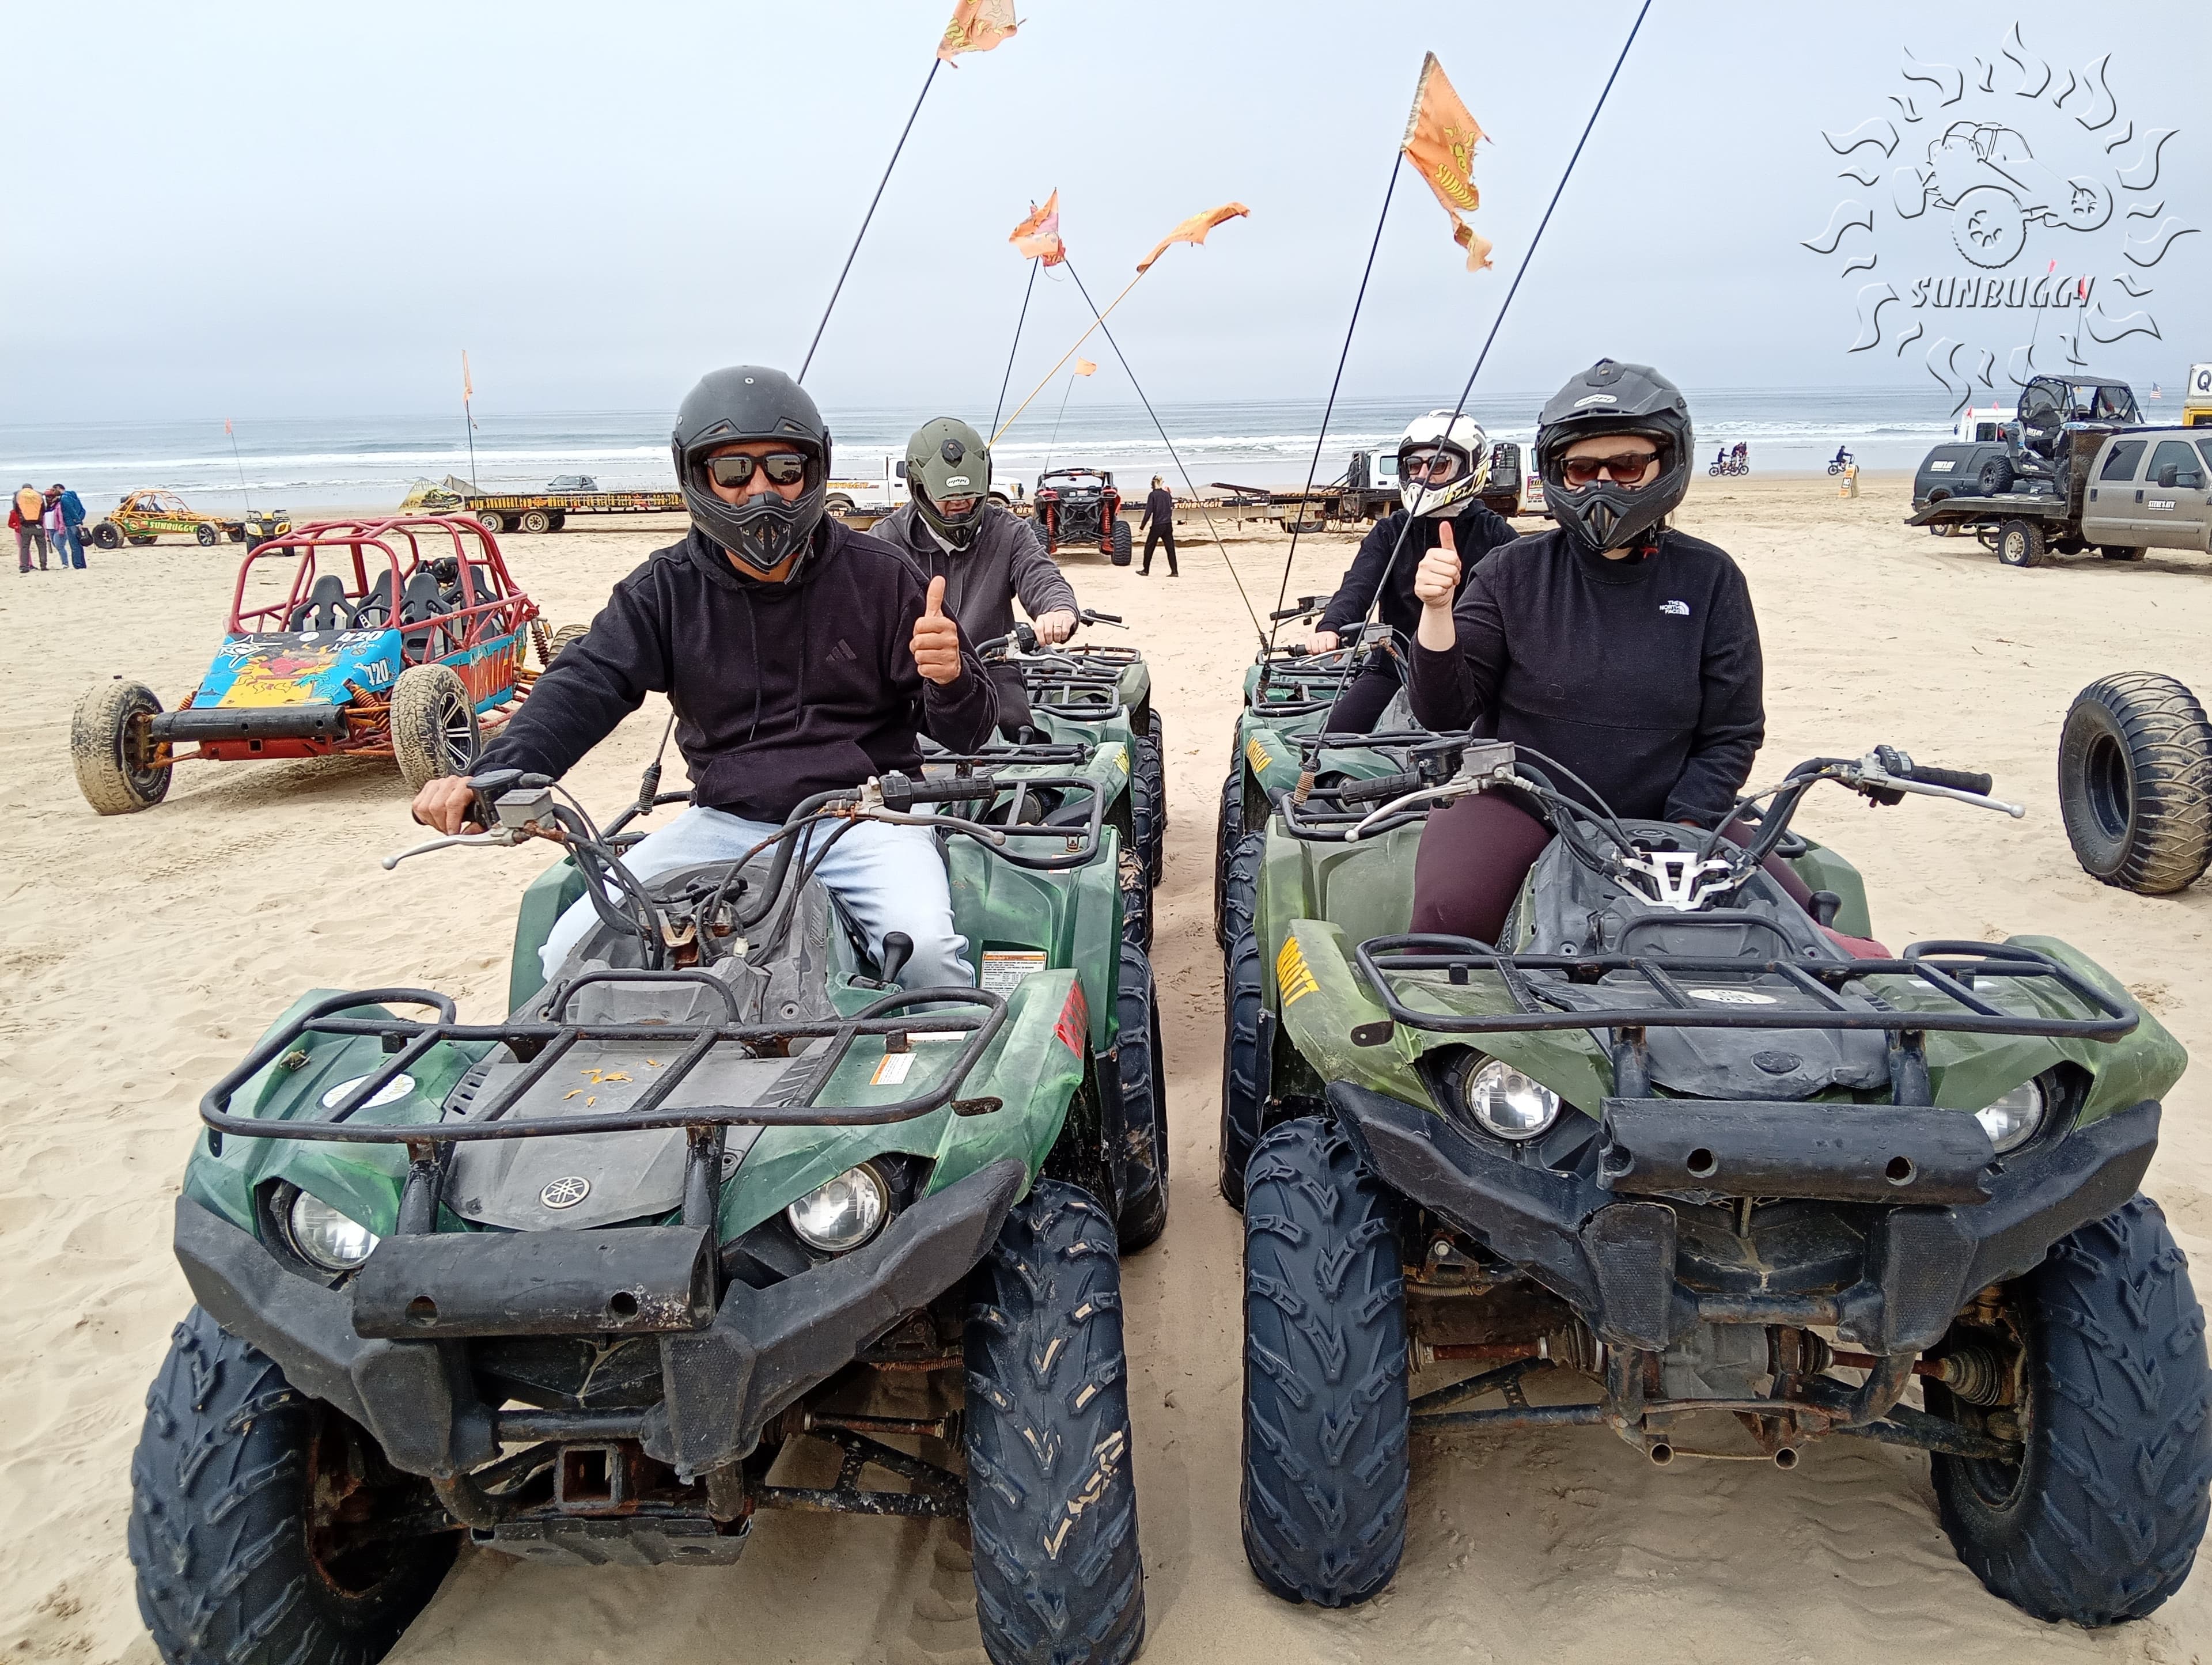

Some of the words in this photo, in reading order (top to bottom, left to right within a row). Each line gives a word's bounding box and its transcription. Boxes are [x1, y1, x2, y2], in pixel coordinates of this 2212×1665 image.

[1174, 501, 1224, 509] SUNBUGGIE
[2148, 500, 2166, 508] STEVE'S
[150, 521, 198, 532] SUNBUGGY
[335, 631, 385, 642] 420
